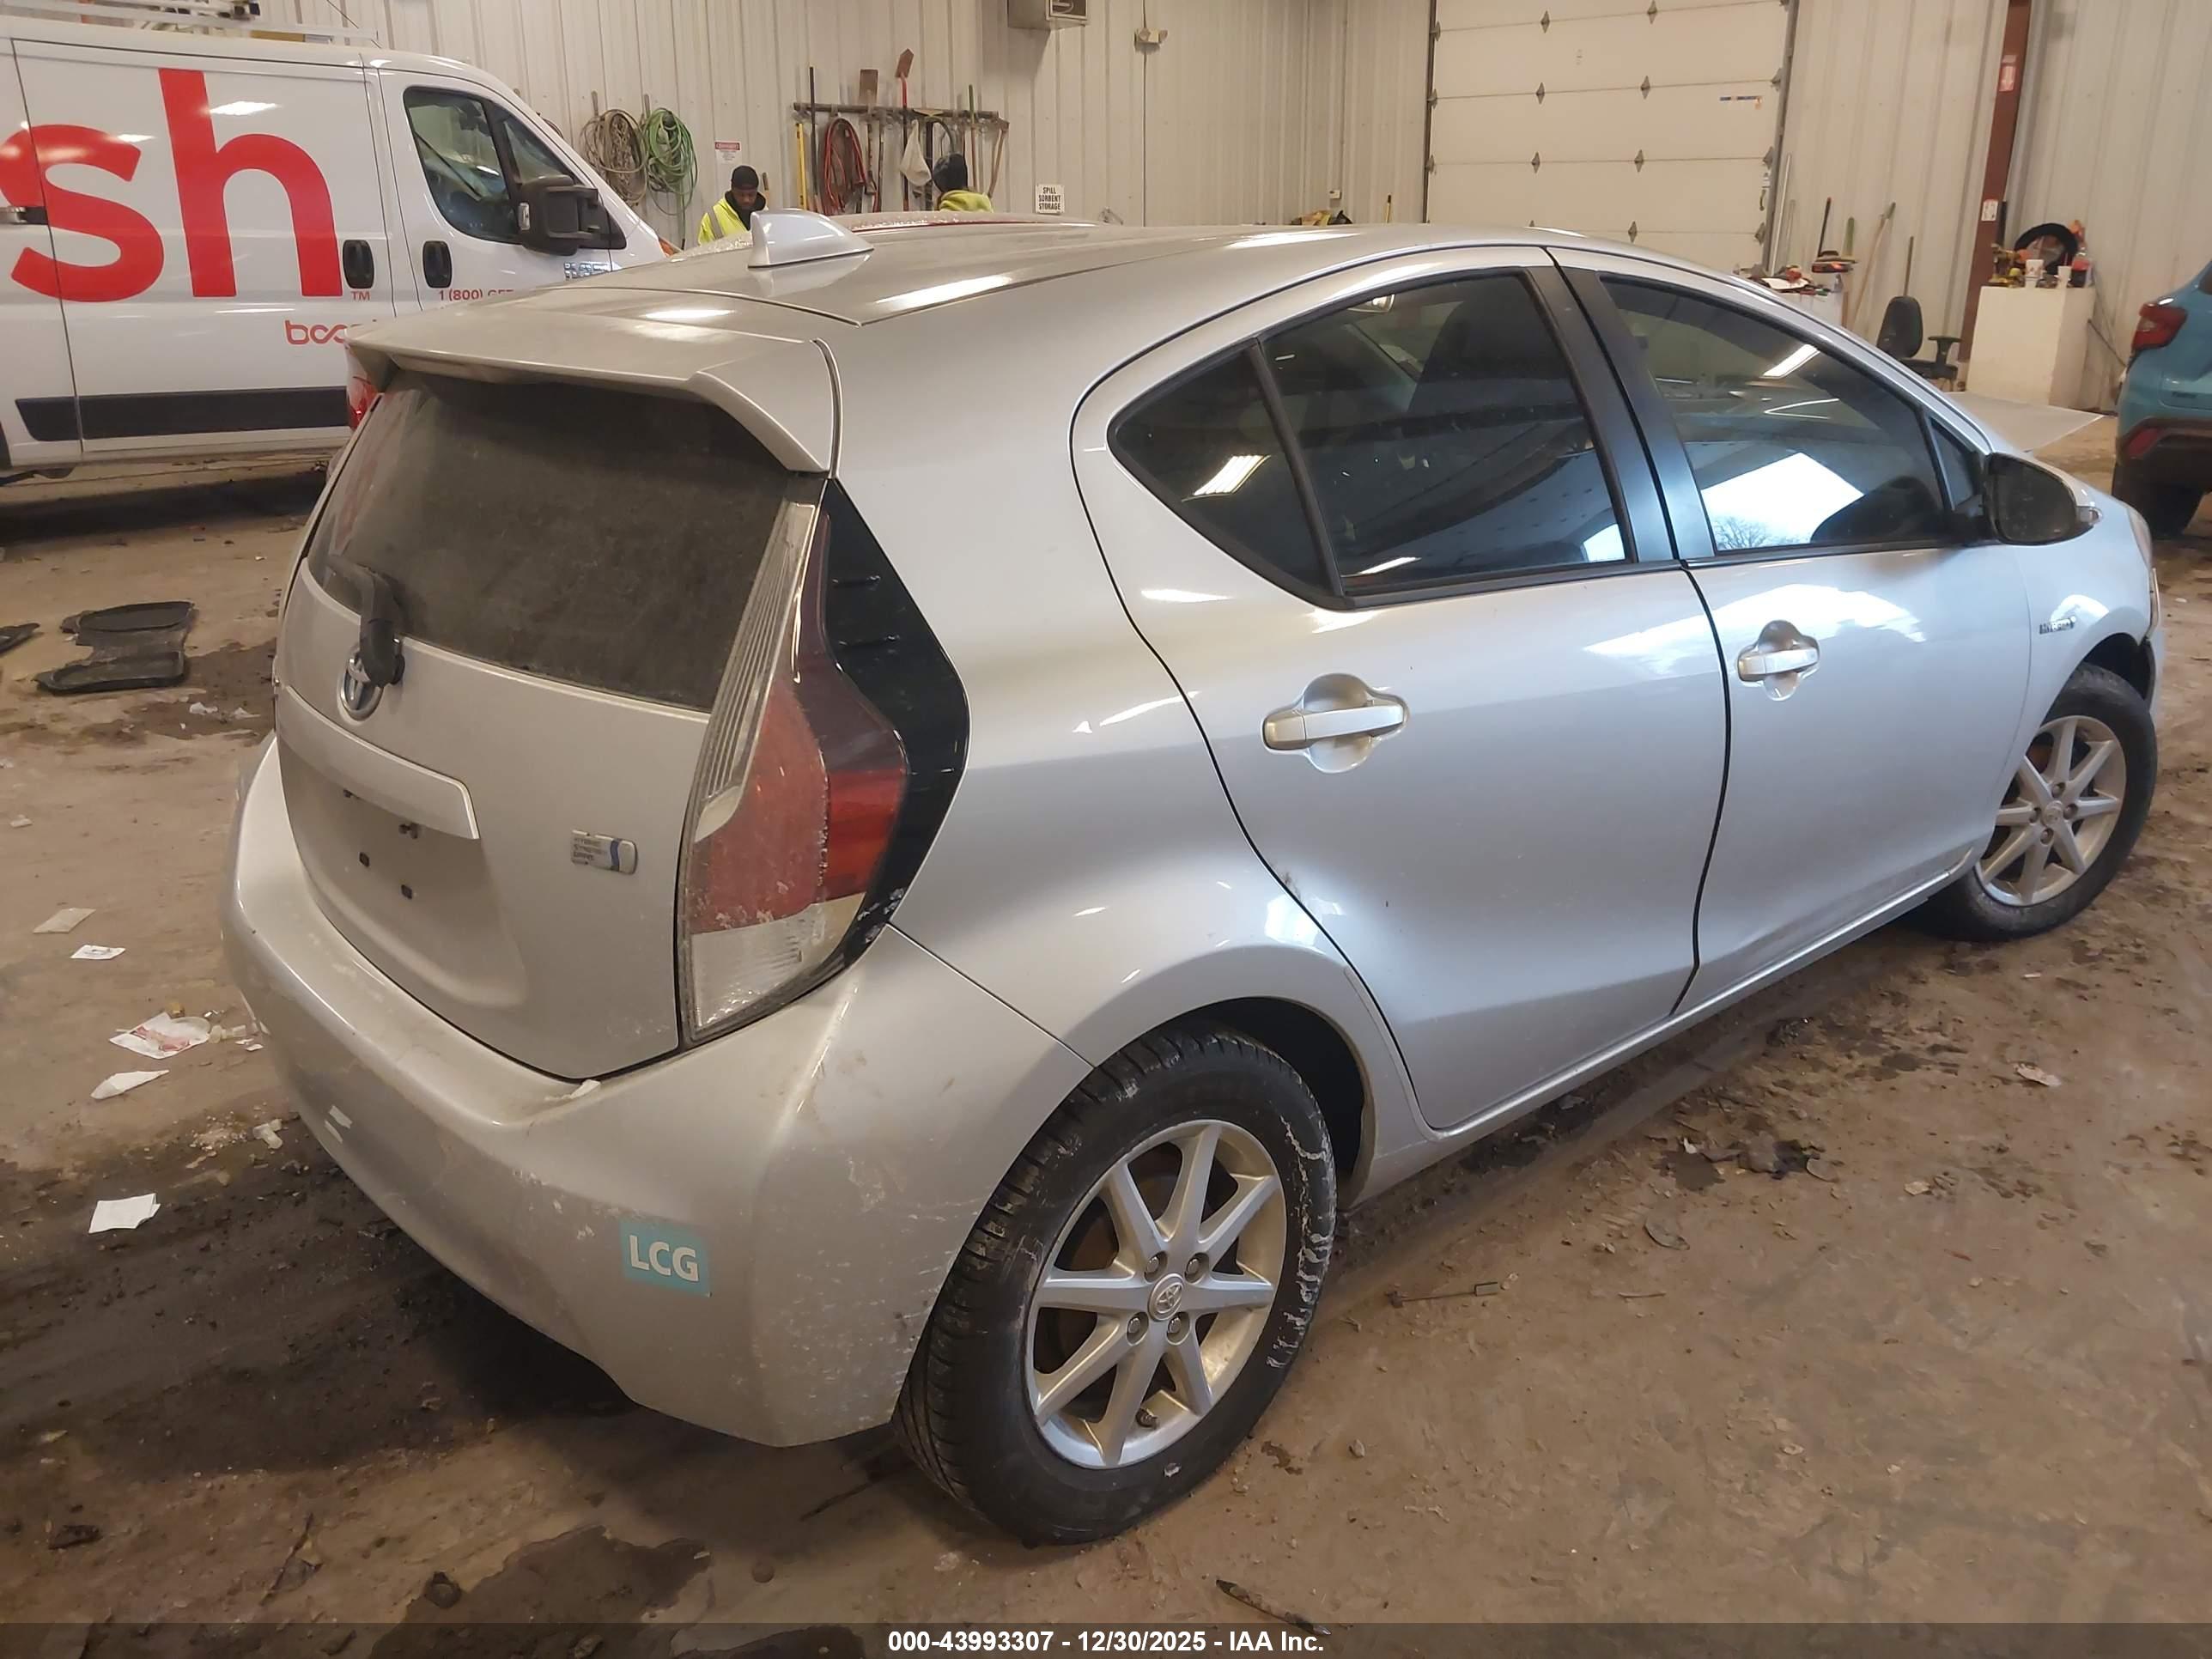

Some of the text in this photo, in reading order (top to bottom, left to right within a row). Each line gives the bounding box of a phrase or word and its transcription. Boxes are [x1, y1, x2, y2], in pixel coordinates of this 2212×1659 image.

[1038, 194, 1061, 203] SORBENT
[350, 291, 371, 301] TM
[439, 289, 444, 301] 1
[449, 289, 483, 301] (800)
[629, 1234, 700, 1283] LCG
